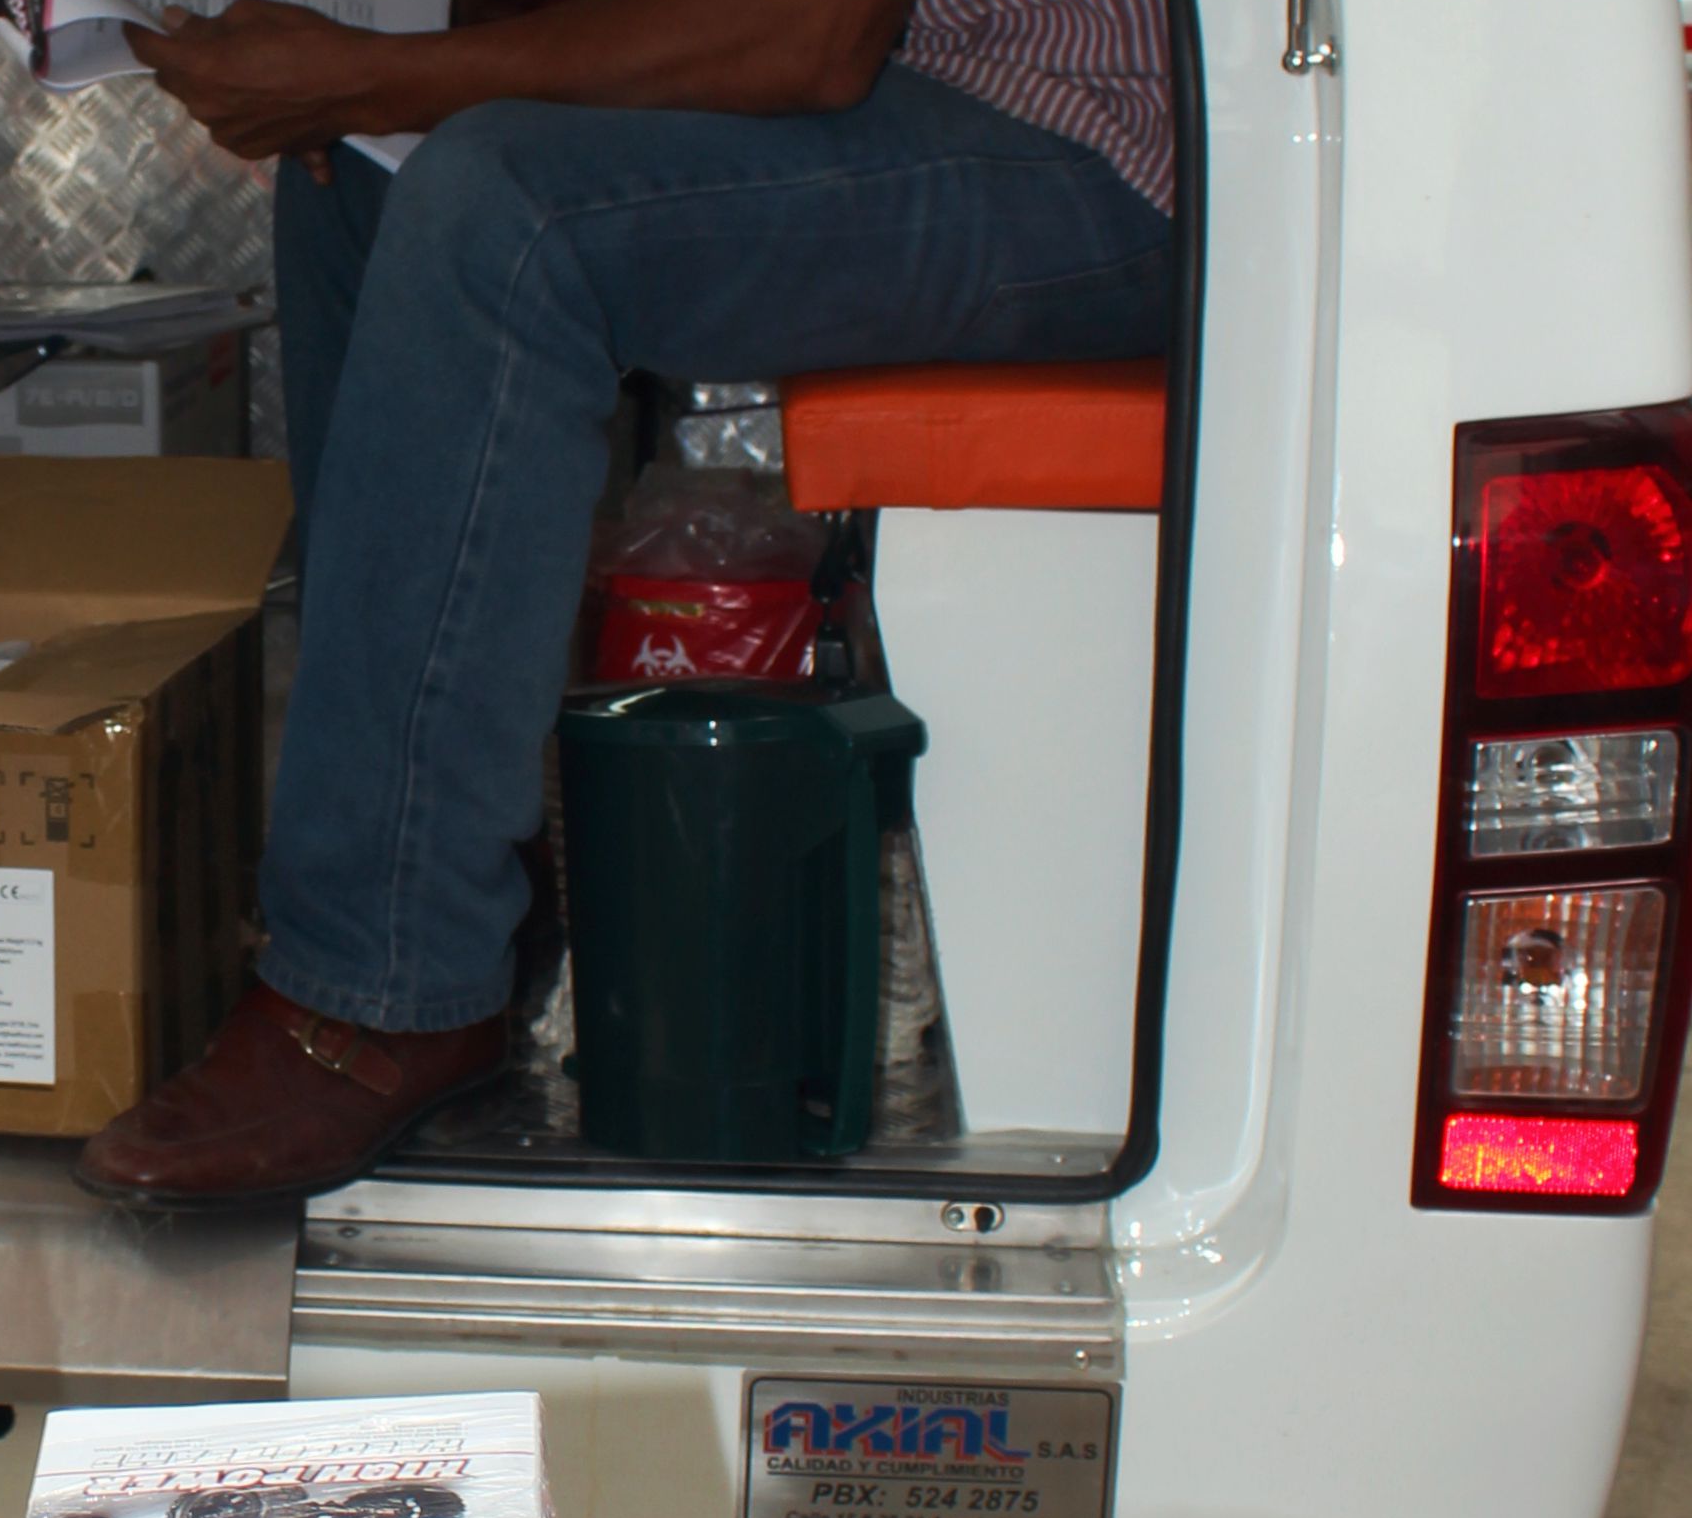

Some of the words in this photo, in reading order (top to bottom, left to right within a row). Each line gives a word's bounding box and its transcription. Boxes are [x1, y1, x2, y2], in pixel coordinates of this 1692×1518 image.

[897, 1388, 1010, 1407] INDUSTRIAS
[763, 1402, 1032, 1463] AXIAL
[767, 1456, 852, 1472] CALIDAD
[858, 1459, 873, 1473] Y
[877, 1460, 1025, 1479] CUMPLIMIENTO
[811, 1482, 886, 1507] PBX:
[905, 1486, 958, 1510] 524
[968, 1488, 1040, 1513] 2875
